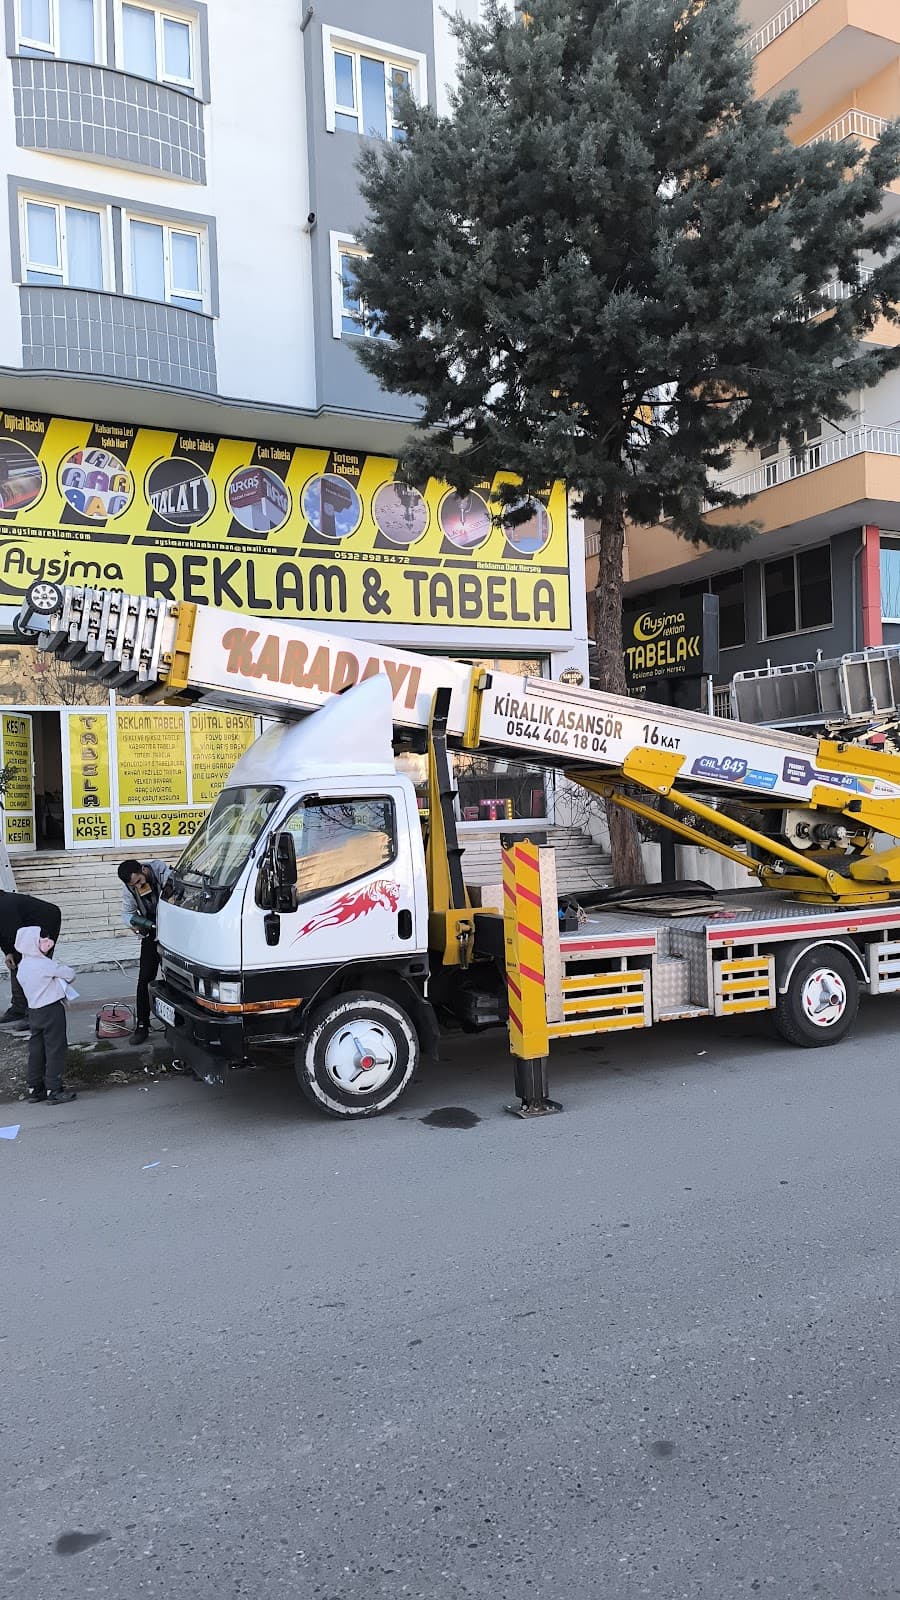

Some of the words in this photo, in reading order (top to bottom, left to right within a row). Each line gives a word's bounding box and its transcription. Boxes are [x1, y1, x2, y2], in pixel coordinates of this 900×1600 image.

[4, 414, 26, 433] Dijital
[25, 416, 45, 433] Baskı
[94, 424, 123, 436] Kabartma
[123, 427, 134, 438] Led
[116, 438, 129, 449] Harf
[180, 437, 196, 452] Cephe
[196, 439, 214, 453] Tabela
[270, 447, 291, 461] Tabela
[333, 451, 359, 465] Totem
[332, 463, 360, 476] Tabela
[334, 552, 360, 560] 0532
[383, 555, 398, 564] 54
[398, 556, 410, 564] 72
[4, 548, 124, 586] Aysima
[476, 562, 504, 571] Reklama
[146, 552, 347, 613] REKLAM
[362, 568, 391, 616] &
[404, 570, 556, 623] TABELA
[643, 612, 685, 633] Aysima
[662, 624, 685, 636] reklam
[222, 627, 422, 710] KARADAYI
[119, 716, 152, 730] REKLAM
[154, 716, 184, 730] TABELA
[191, 716, 224, 731] DİJİTAL
[226, 716, 254, 729] BASKI
[494, 693, 553, 726] KİRALIK
[556, 709, 623, 740] ASANSÖR
[6, 720, 26, 734] KESİM
[506, 721, 540, 741] 0544
[544, 728, 568, 746] 404
[573, 734, 588, 750] 18
[592, 737, 608, 754] 04
[642, 724, 658, 745] 16
[661, 736, 680, 750] KAT
[722, 760, 744, 773] 845
[8, 819, 30, 828] LAZER
[78, 814, 106, 824] ACİL
[8, 830, 30, 842] KESİM
[76, 825, 108, 839] KAŞE
[126, 823, 136, 838] 0
[142, 822, 171, 837] 532
[178, 820, 201, 835] 29
